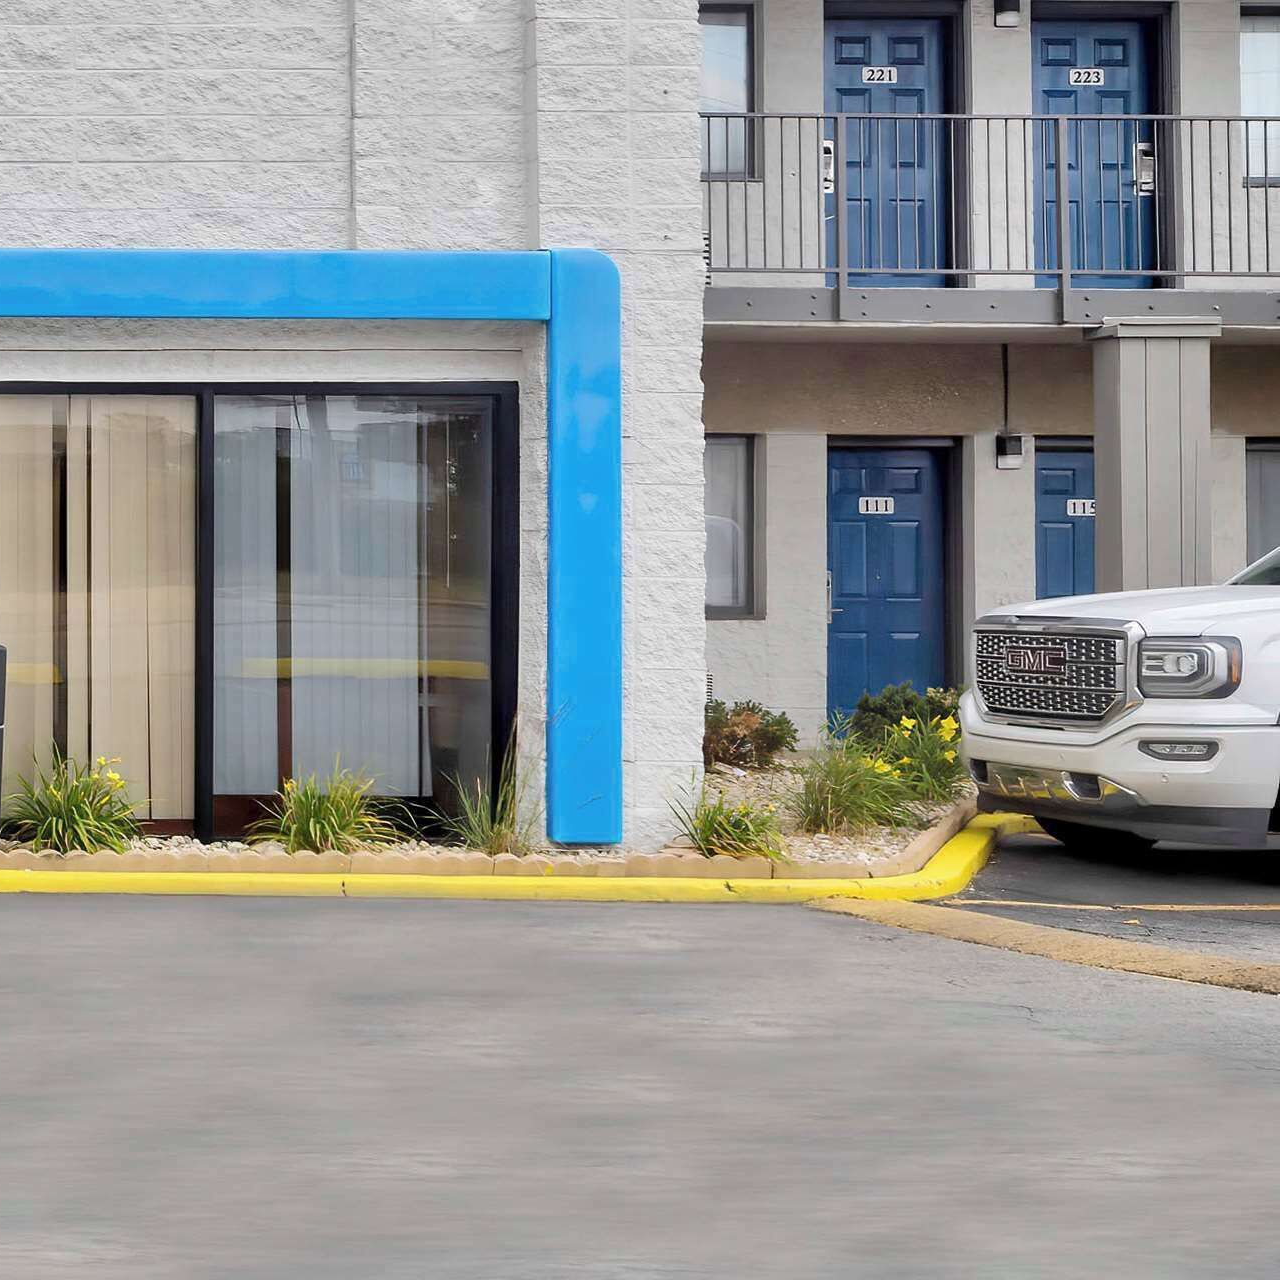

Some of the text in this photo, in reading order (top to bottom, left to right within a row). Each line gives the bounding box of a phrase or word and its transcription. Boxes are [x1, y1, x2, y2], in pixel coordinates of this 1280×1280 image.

[866, 69, 892, 81] 221
[1074, 71, 1100, 83] 223
[865, 499, 888, 512] 111
[1007, 649, 1064, 672] GMC
